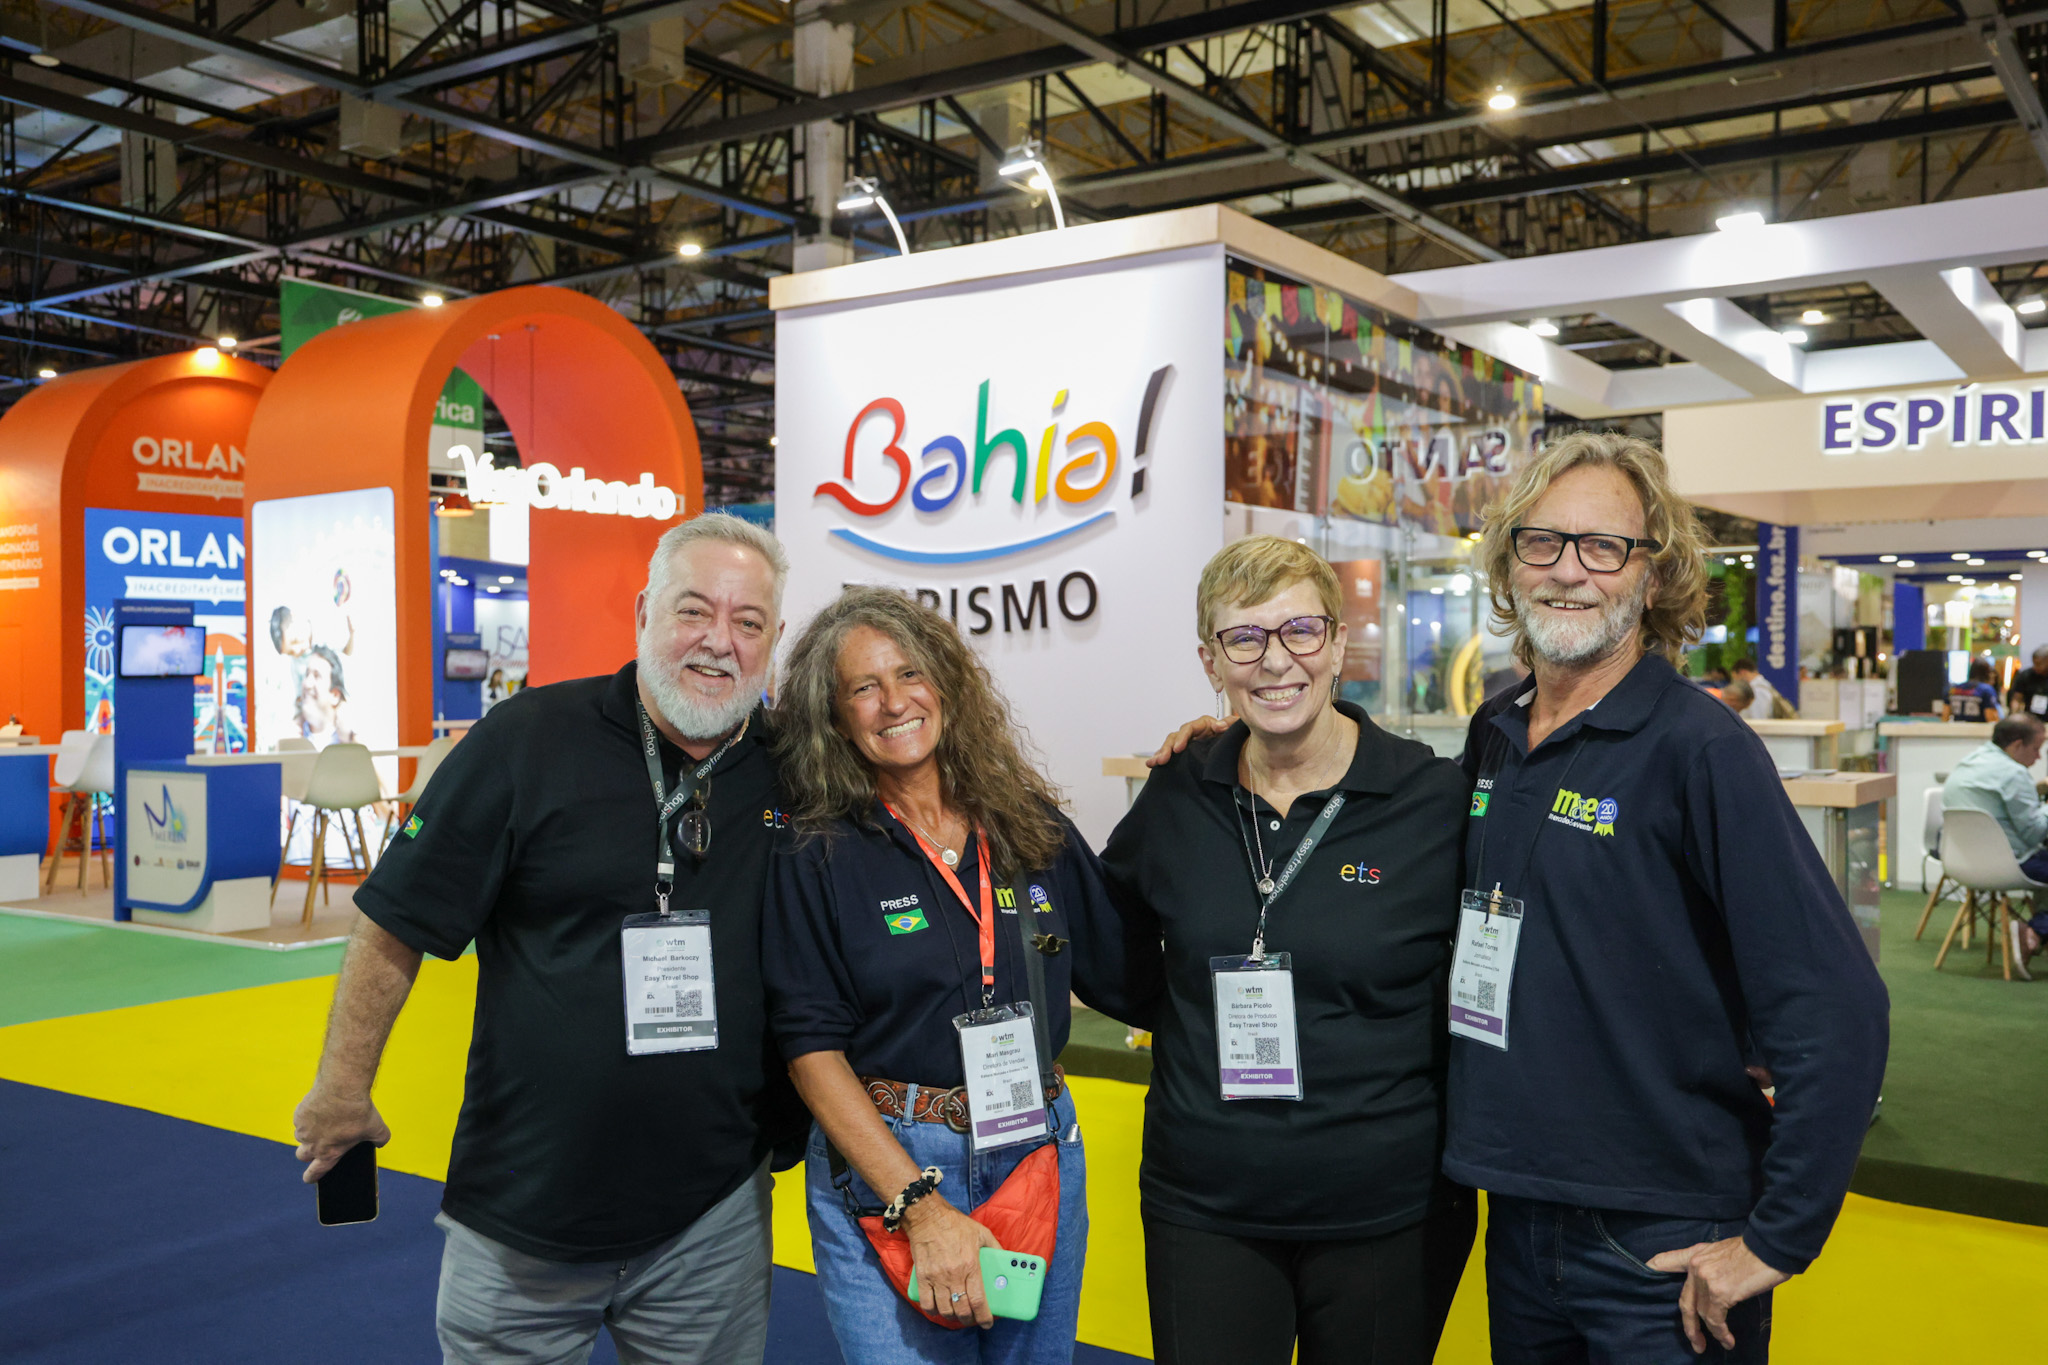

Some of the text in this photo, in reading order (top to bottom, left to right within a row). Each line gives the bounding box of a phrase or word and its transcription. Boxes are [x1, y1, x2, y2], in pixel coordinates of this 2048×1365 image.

[1824, 382, 2046, 451] ESPÍRI
[814, 363, 1173, 517] Bahia!
[1601, 803, 1615, 815] 20
[1340, 862, 1381, 884] ets
[880, 894, 919, 911] PRESS
[1483, 926, 1498, 934] wtm
[998, 1032, 1014, 1040] wtm
[997, 1117, 1028, 1128] EXHIBITOR
